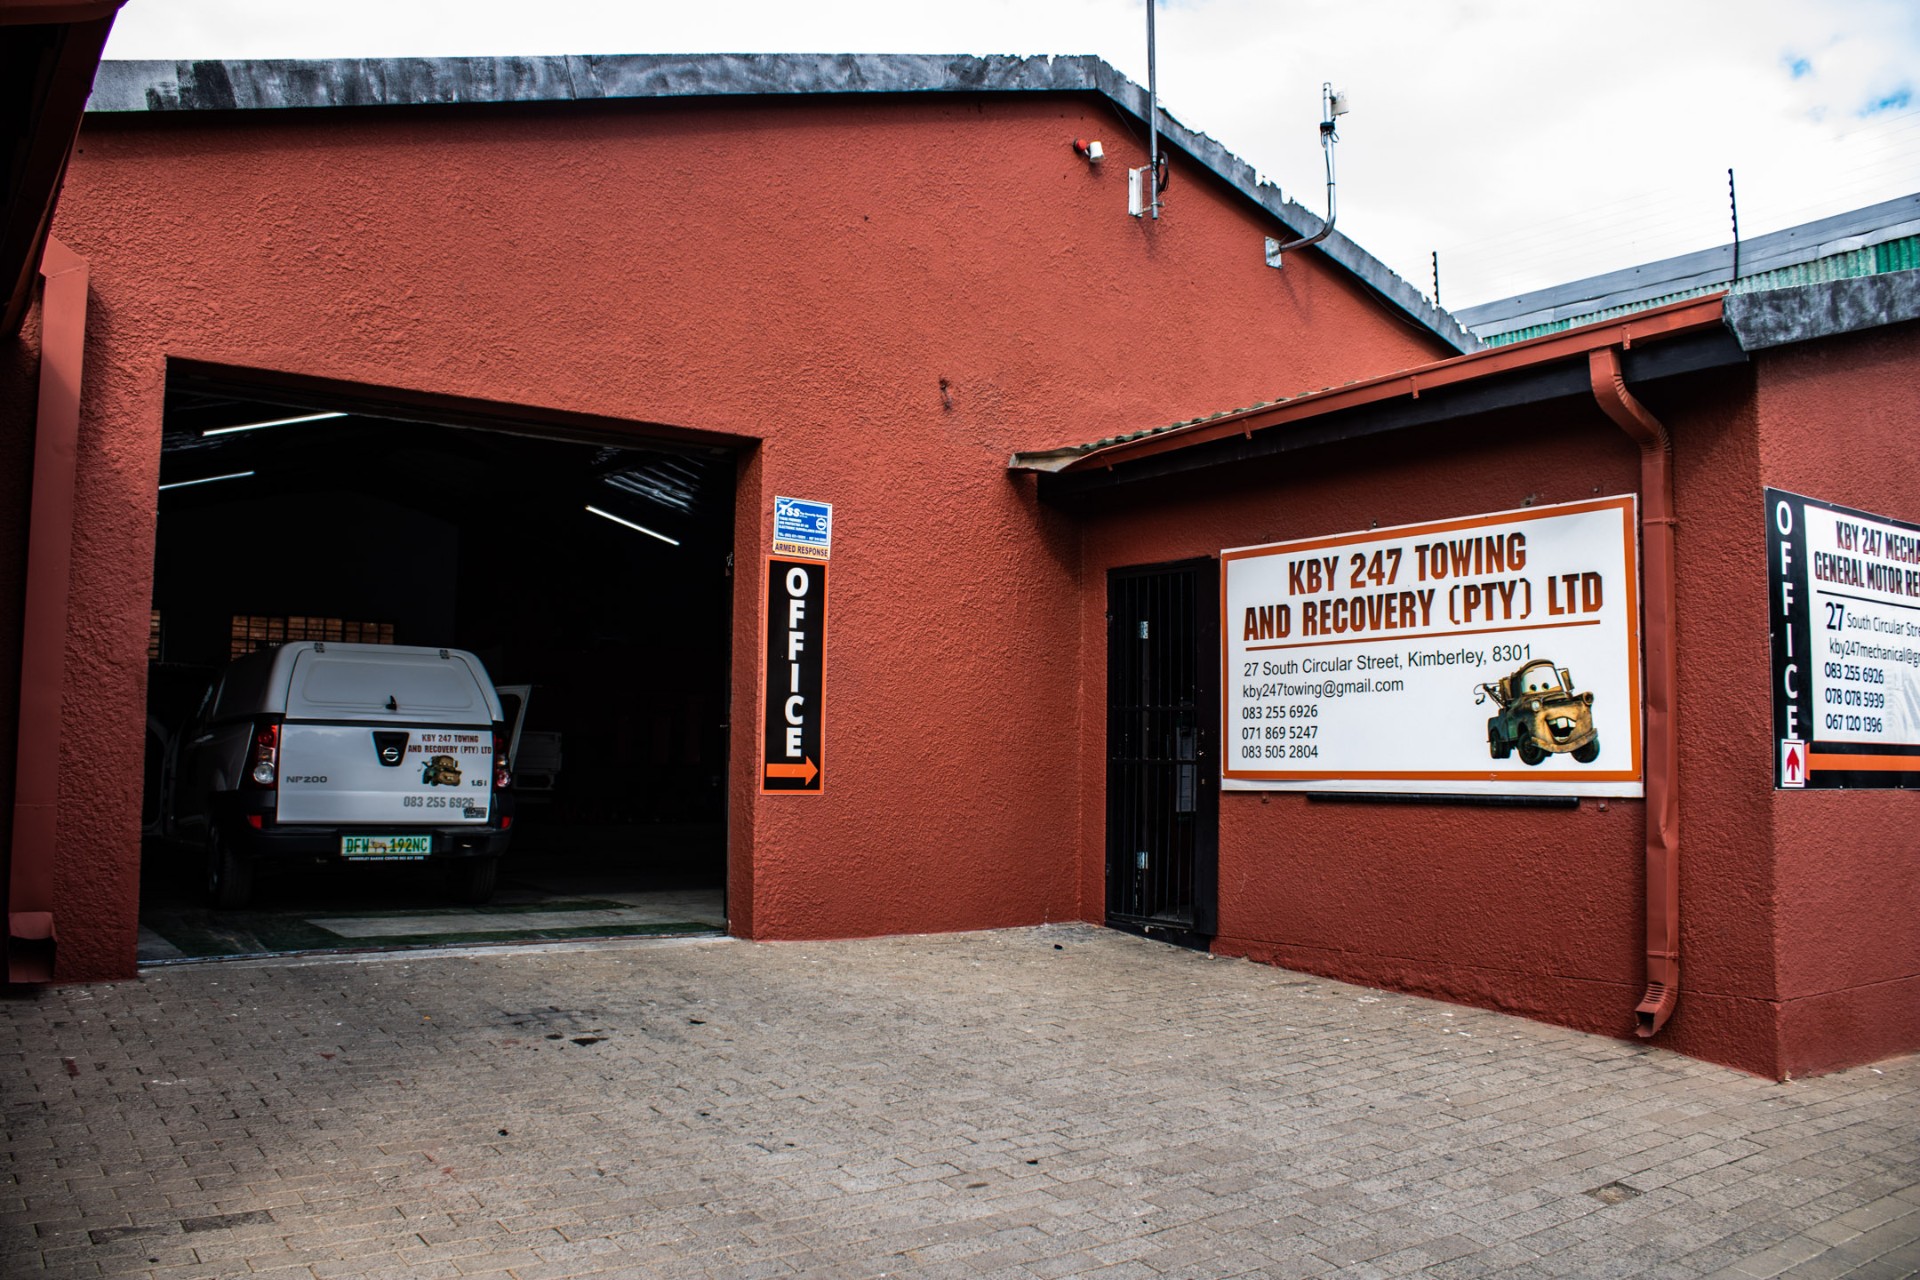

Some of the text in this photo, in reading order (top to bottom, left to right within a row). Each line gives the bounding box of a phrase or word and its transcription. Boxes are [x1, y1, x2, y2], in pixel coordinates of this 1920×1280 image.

[779, 504, 801, 517] TSS
[1836, 520, 1859, 552] KBY
[1861, 526, 1882, 557] 247
[775, 543, 828, 557] ARMED RESPONSE
[1289, 532, 1526, 596] KBY 247 TOWING
[1814, 550, 1920, 597] GENERAL MOTOR RE
[1243, 571, 1603, 641] AND RECOVERY (PTY) LTD
[1776, 500, 1799, 739] OFFICE
[1825, 601, 1845, 631] 27
[1847, 612, 1871, 630] South
[1873, 616, 1904, 635] Circular
[785, 567, 809, 757] OFFICE
[1244, 643, 1530, 677] 27 South Circular Street, Kimberley, 8301
[1829, 637, 1920, 668] kby247mechanical@g
[1824, 661, 1885, 685] 083 255 6926
[1243, 678, 1404, 701] kby247towing@gmail.com
[1824, 687, 1885, 709] 078 078 5939
[1242, 704, 1318, 719] 083 255 6926
[1242, 725, 1318, 740] 071 869 5247
[1825, 713, 1883, 733] 067 120 1396
[408, 745, 492, 754] AND RECOVERY (PTY) LTD
[421, 734, 479, 743] KBY 247 TOWING
[1242, 744, 1318, 758] 083 505 2804
[286, 775, 328, 783] NP200
[403, 796, 475, 809] 083 255 6926
[346, 838, 428, 852] DFW 192NC
